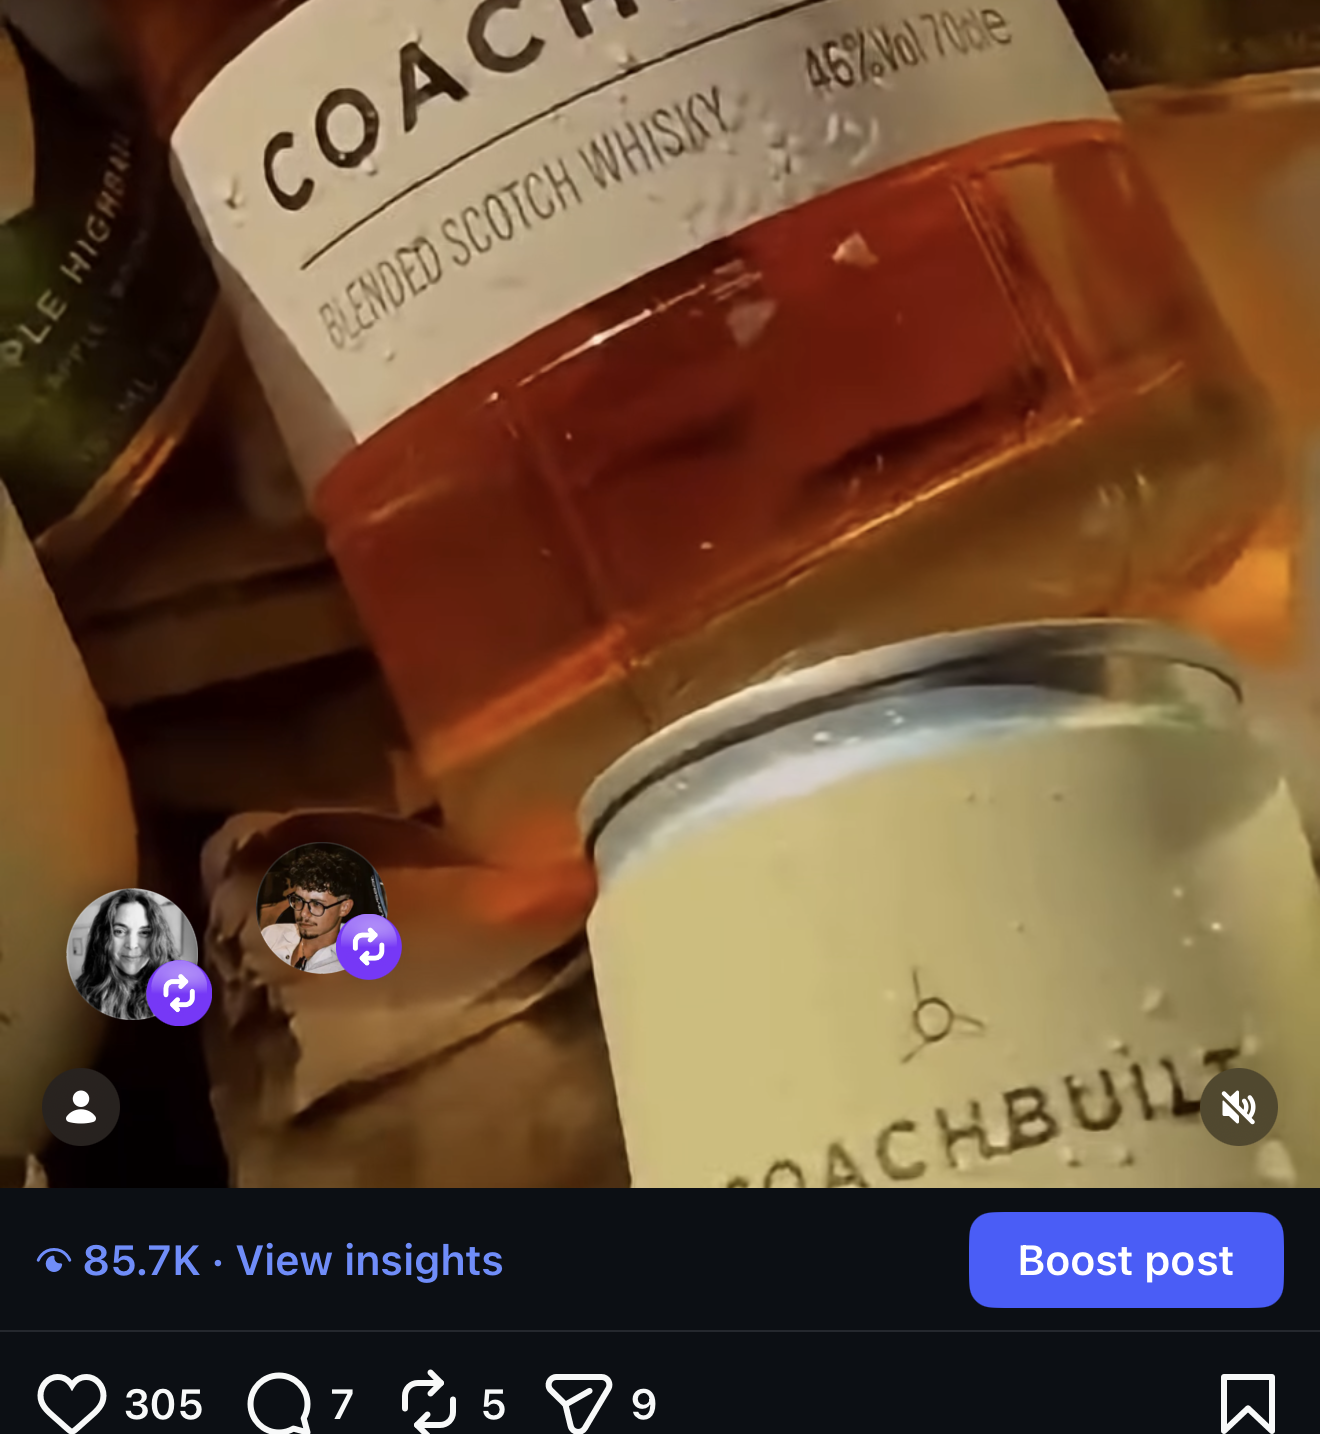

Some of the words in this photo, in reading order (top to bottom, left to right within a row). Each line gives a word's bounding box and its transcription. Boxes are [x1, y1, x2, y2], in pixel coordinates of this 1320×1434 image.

[318, 235, 444, 351] BLENDED
[440, 157, 584, 267] SCOTCH
[577, 84, 732, 191] WHISKY
